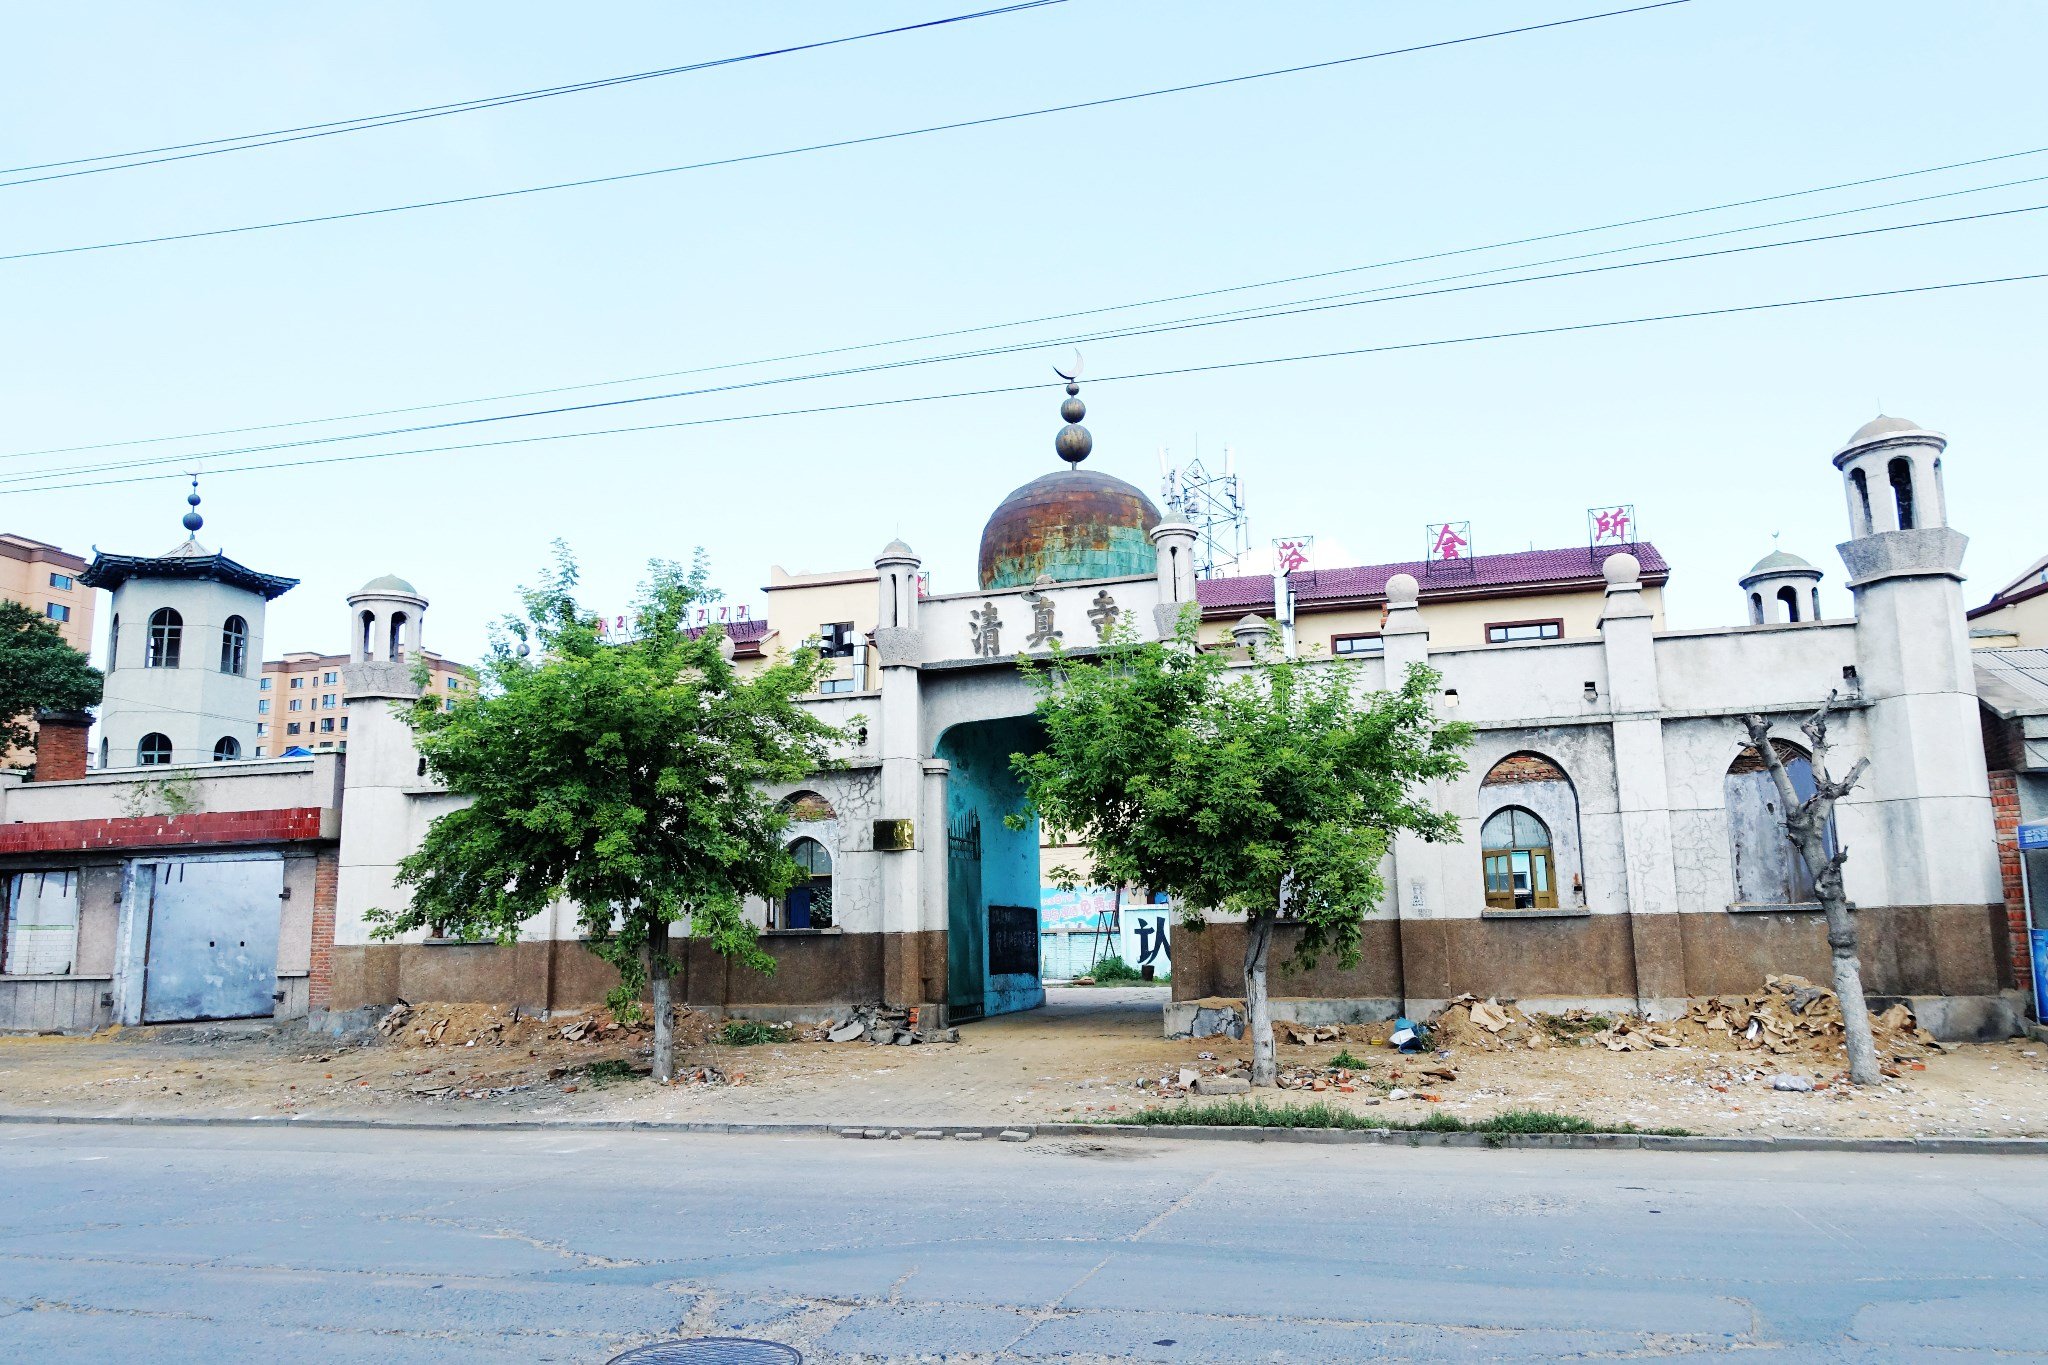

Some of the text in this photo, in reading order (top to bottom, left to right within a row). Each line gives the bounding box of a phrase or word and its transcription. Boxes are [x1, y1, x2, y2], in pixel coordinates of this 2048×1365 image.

[968, 589, 1120, 657] 清真寺
[1134, 916, 1171, 965] 认
